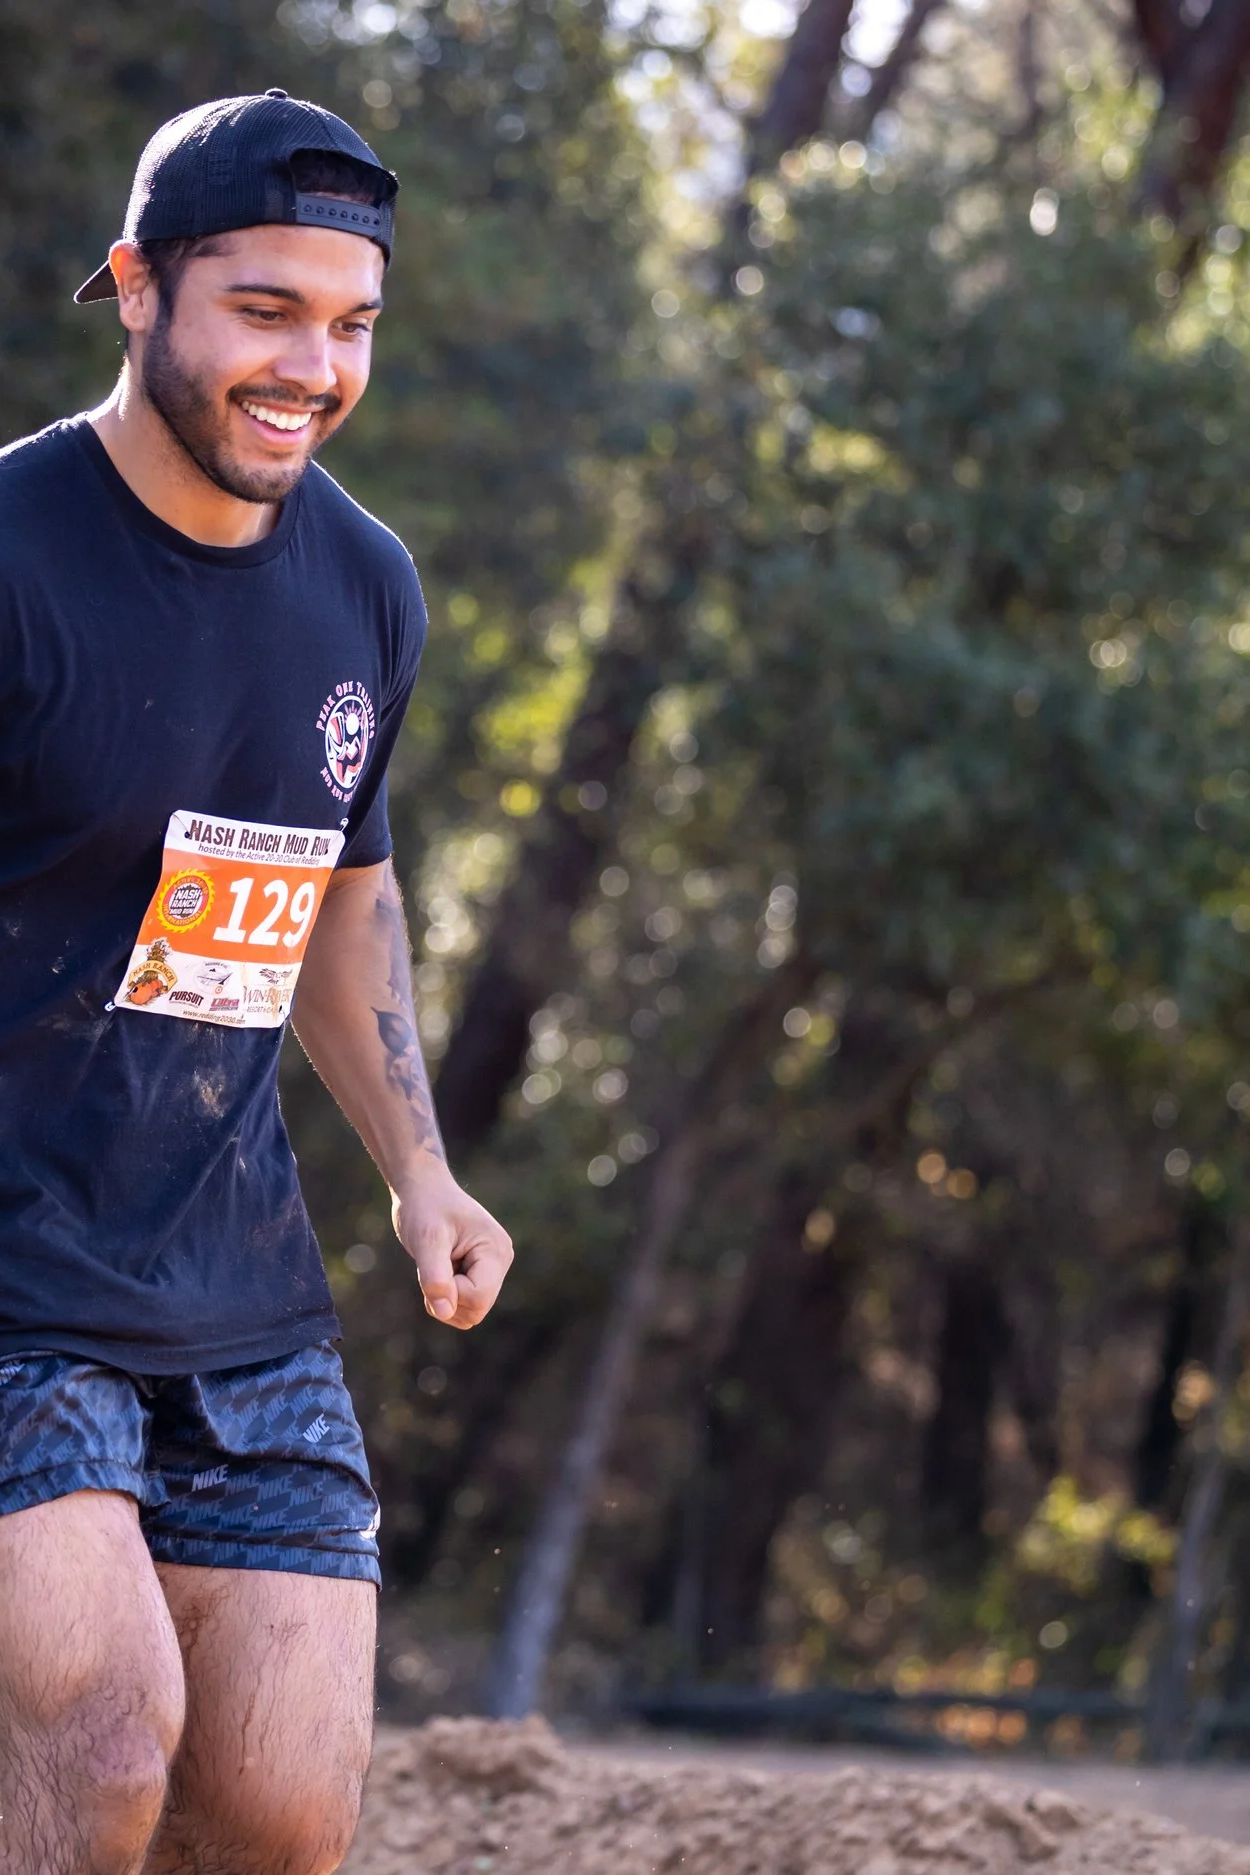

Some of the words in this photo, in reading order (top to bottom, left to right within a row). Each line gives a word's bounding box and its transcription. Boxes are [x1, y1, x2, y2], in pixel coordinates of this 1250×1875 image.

[316, 694, 336, 731] PEAK
[335, 680, 354, 697] ONE
[188, 819, 236, 848] NASH
[238, 828, 282, 853] RANCH
[283, 833, 309, 855] MUD
[198, 843, 225, 856] hosted
[226, 848, 235, 858] by
[235, 850, 246, 859] the
[247, 851, 265, 861] Active
[265, 854, 283, 863] 20-30
[171, 899, 198, 908] RANCH
[175, 888, 202, 900] NASH
[213, 877, 315, 948] 129
[133, 962, 152, 977] NASH
[152, 962, 175, 982] RANCH
[169, 990, 204, 1007] PURSUIT
[302, 1412, 330, 1443] NIKE
[192, 1464, 228, 1492] NIKE
[225, 1469, 261, 1497] NIKE
[257, 1475, 293, 1502] NIKE
[185, 1500, 223, 1527] NIKE
[217, 1503, 257, 1532] NIKE
[250, 1509, 288, 1533] NIKE
